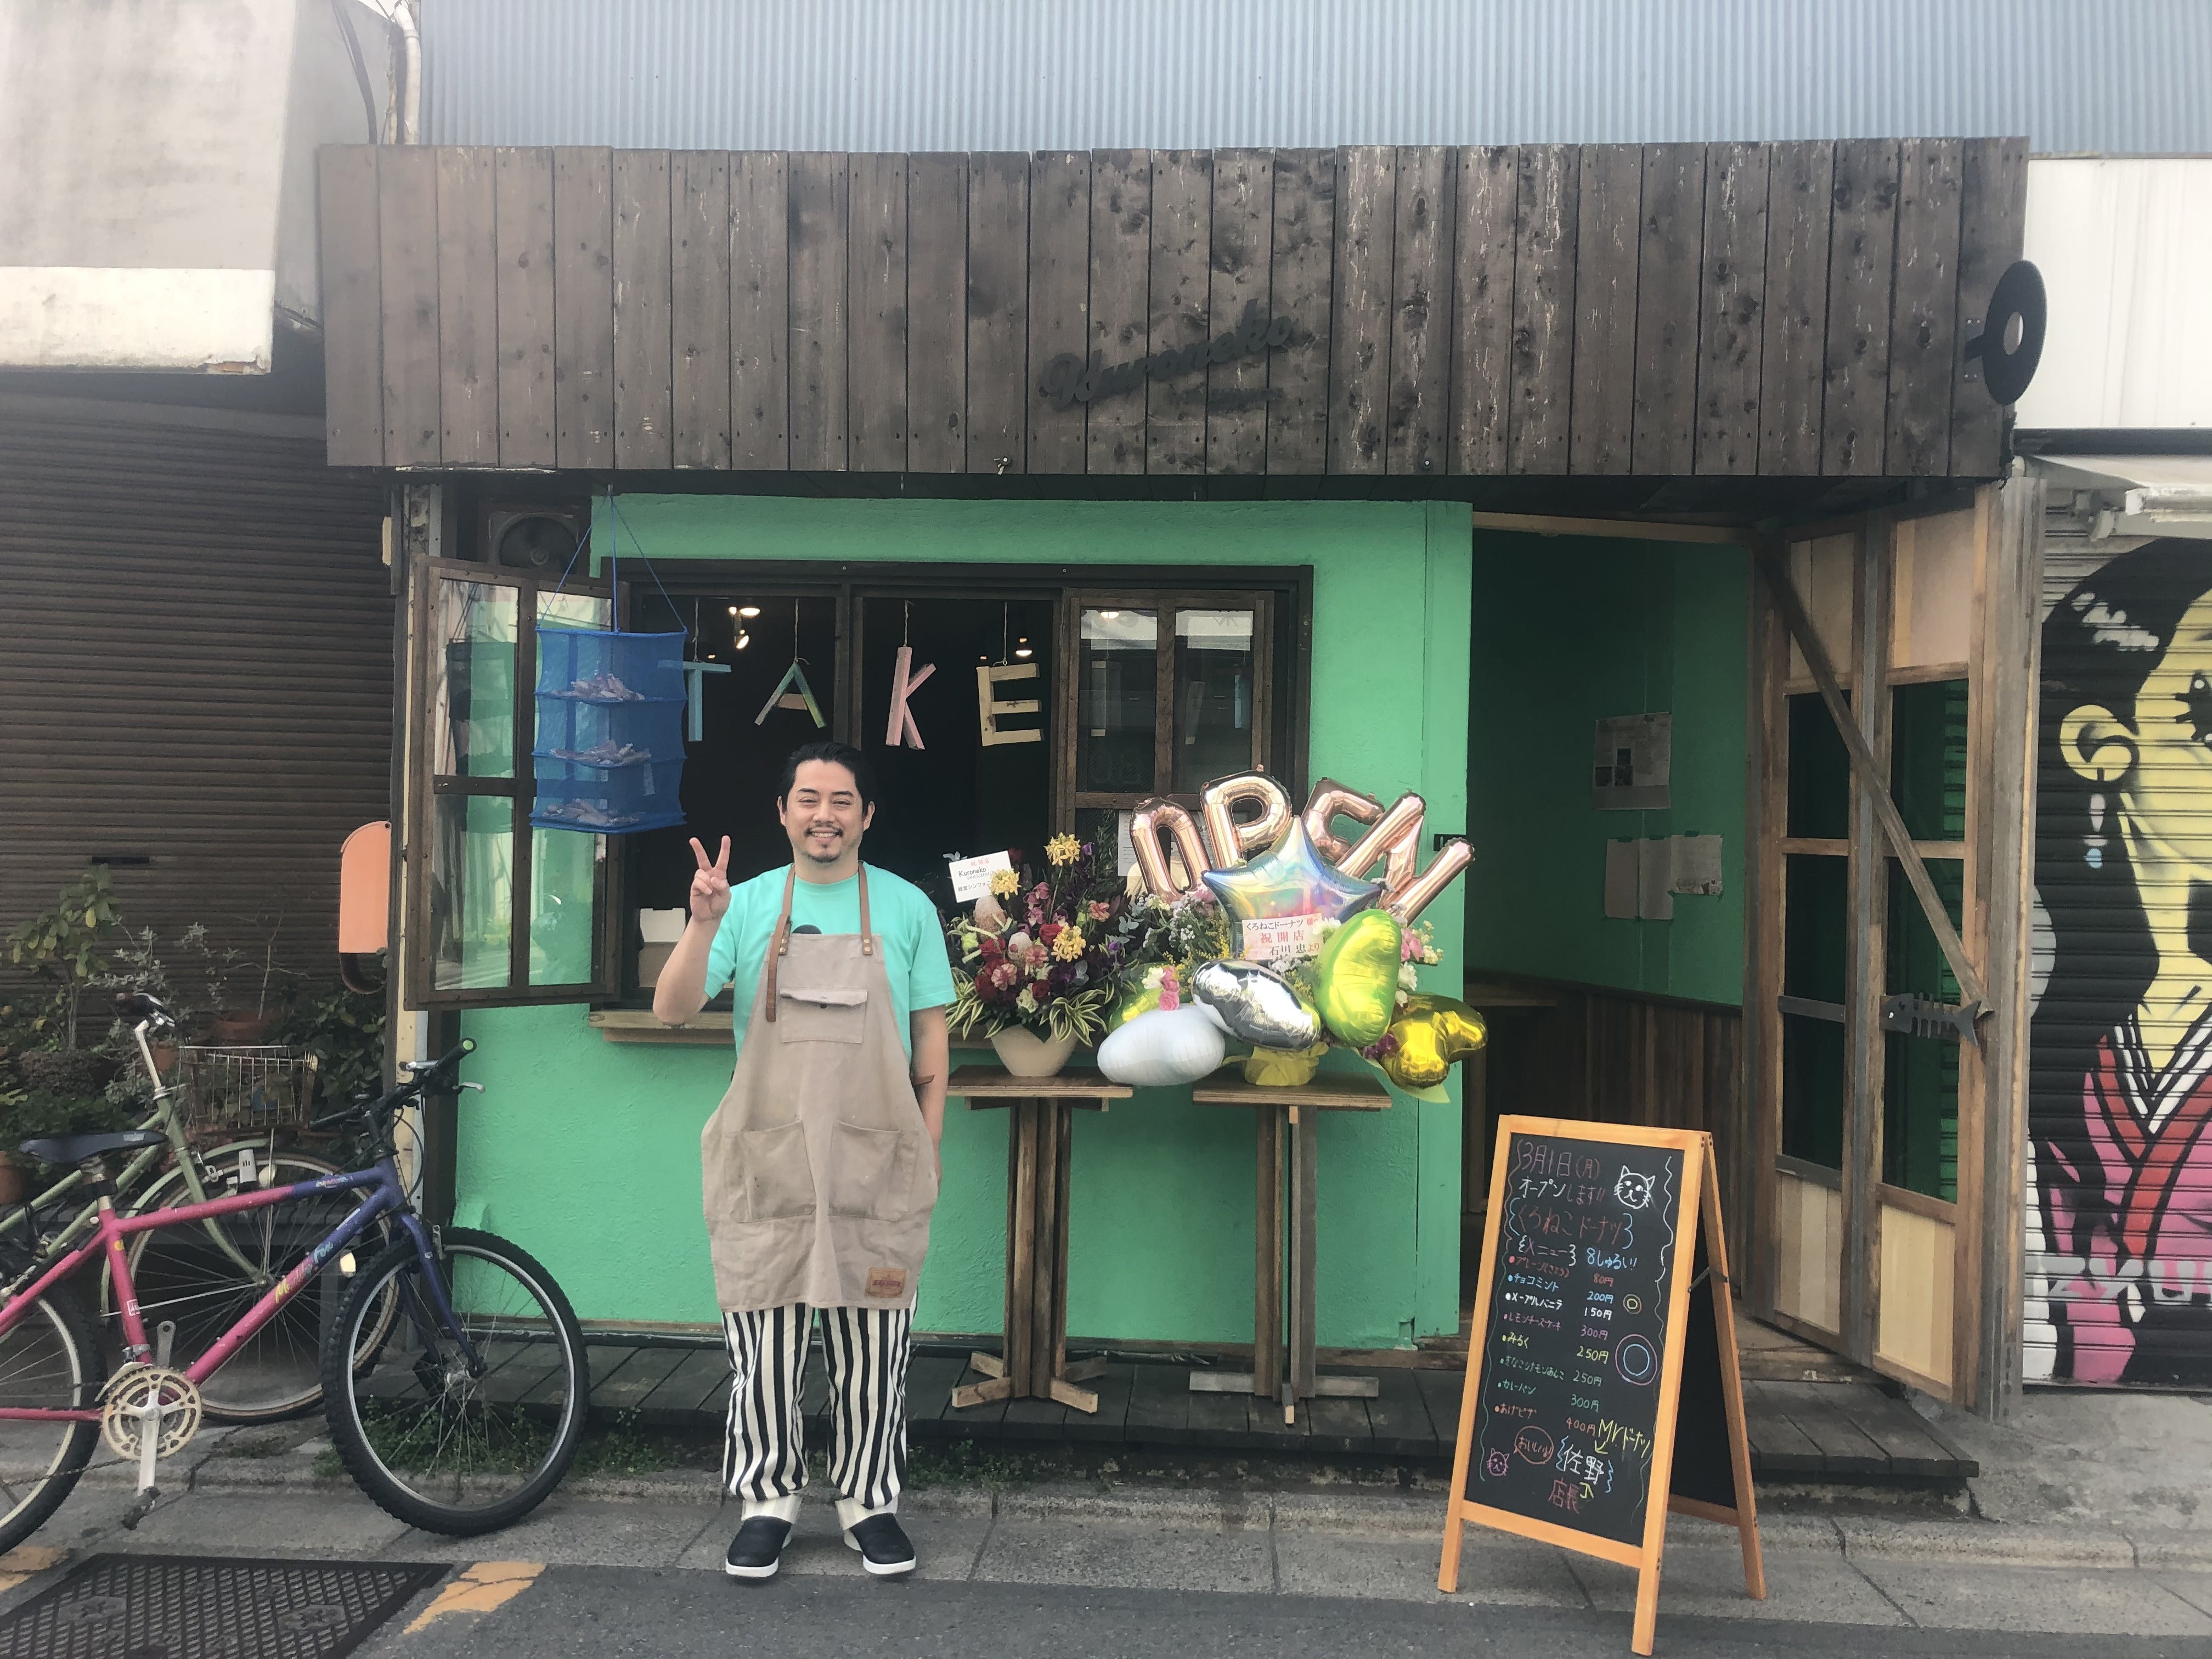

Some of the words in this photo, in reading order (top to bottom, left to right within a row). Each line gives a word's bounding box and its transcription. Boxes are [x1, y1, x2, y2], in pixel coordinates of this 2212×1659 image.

[659, 645, 1044, 750] TAKE
[1130, 765, 1476, 927] OPEN
[958, 866, 986, 877] Kuroneko
[1246, 919, 1304, 931] くろねこドーナツ
[1514, 1273, 1559, 1292] チョコミント
[1587, 1290, 1615, 1304] 200円
[1593, 1273, 1615, 1287] 80円
[1584, 1307, 1613, 1321] 150円
[1580, 1325, 1609, 1340] 300円
[1576, 1346, 1609, 1364] 250円
[1573, 1370, 1602, 1387] 250円
[1502, 1378, 1536, 1395] カレーパン
[1571, 1393, 1599, 1413] 300円
[1566, 1417, 1596, 1436] 400円
[1562, 1443, 1605, 1485] 佐野
[1548, 1477, 1580, 1514] 店長
